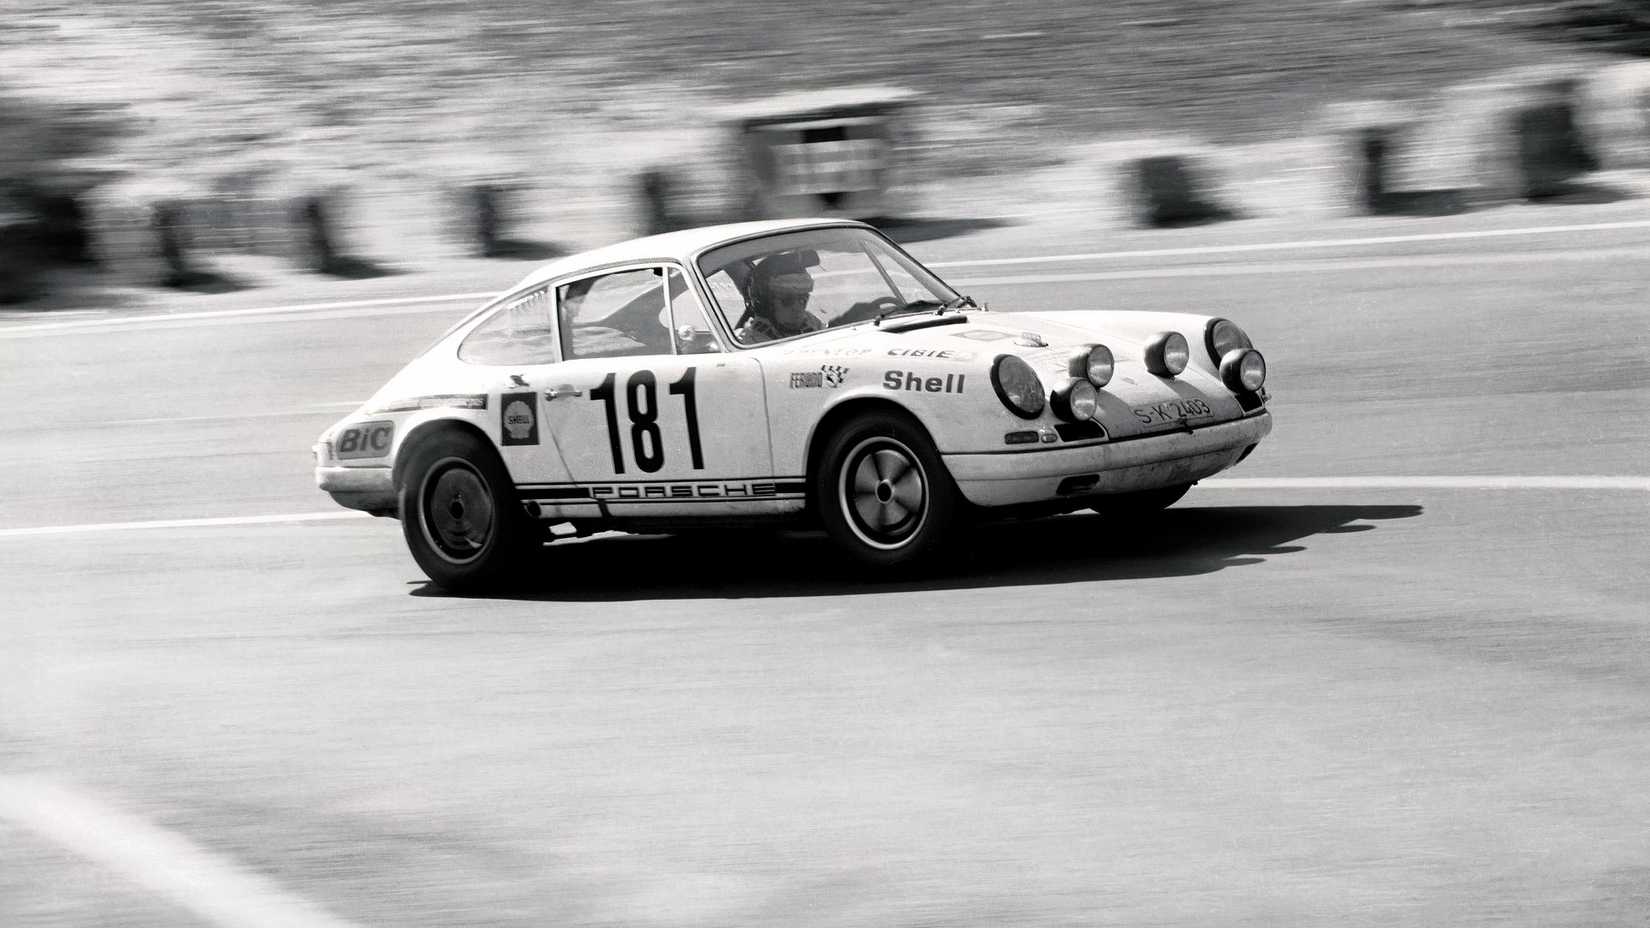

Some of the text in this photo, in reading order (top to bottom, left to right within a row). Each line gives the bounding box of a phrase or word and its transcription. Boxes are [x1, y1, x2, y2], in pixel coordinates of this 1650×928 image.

[882, 370, 966, 394] Shell
[589, 366, 705, 475] 181
[591, 483, 777, 499] PORSCHE
